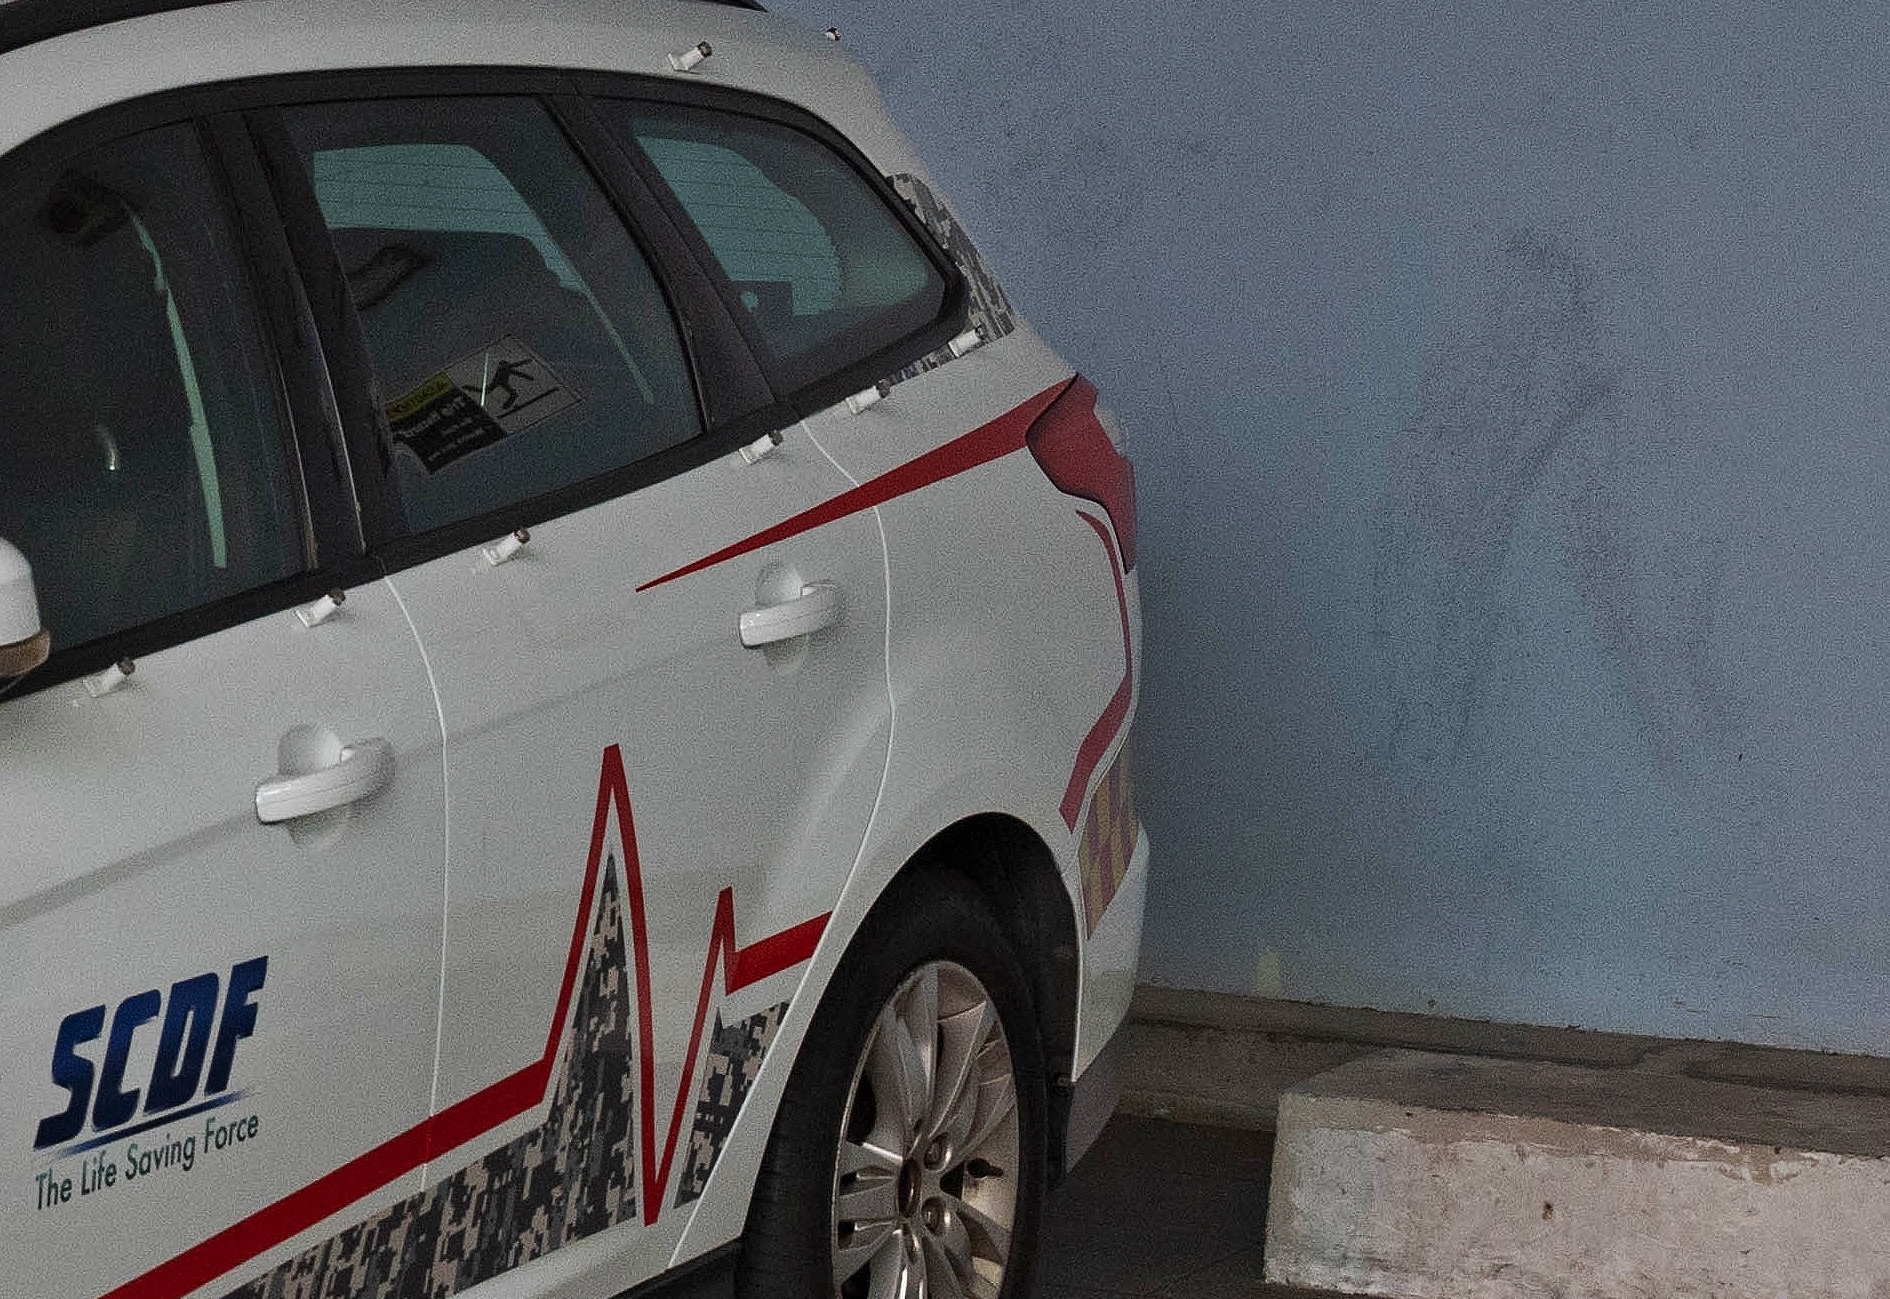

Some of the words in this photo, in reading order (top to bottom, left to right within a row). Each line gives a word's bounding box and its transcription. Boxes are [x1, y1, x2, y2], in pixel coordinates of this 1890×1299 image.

[32, 954, 269, 1151] SCDF
[34, 1169, 73, 1211] The
[80, 1153, 117, 1197] Life
[124, 1133, 197, 1182] Saving
[202, 1113, 260, 1155] Force
